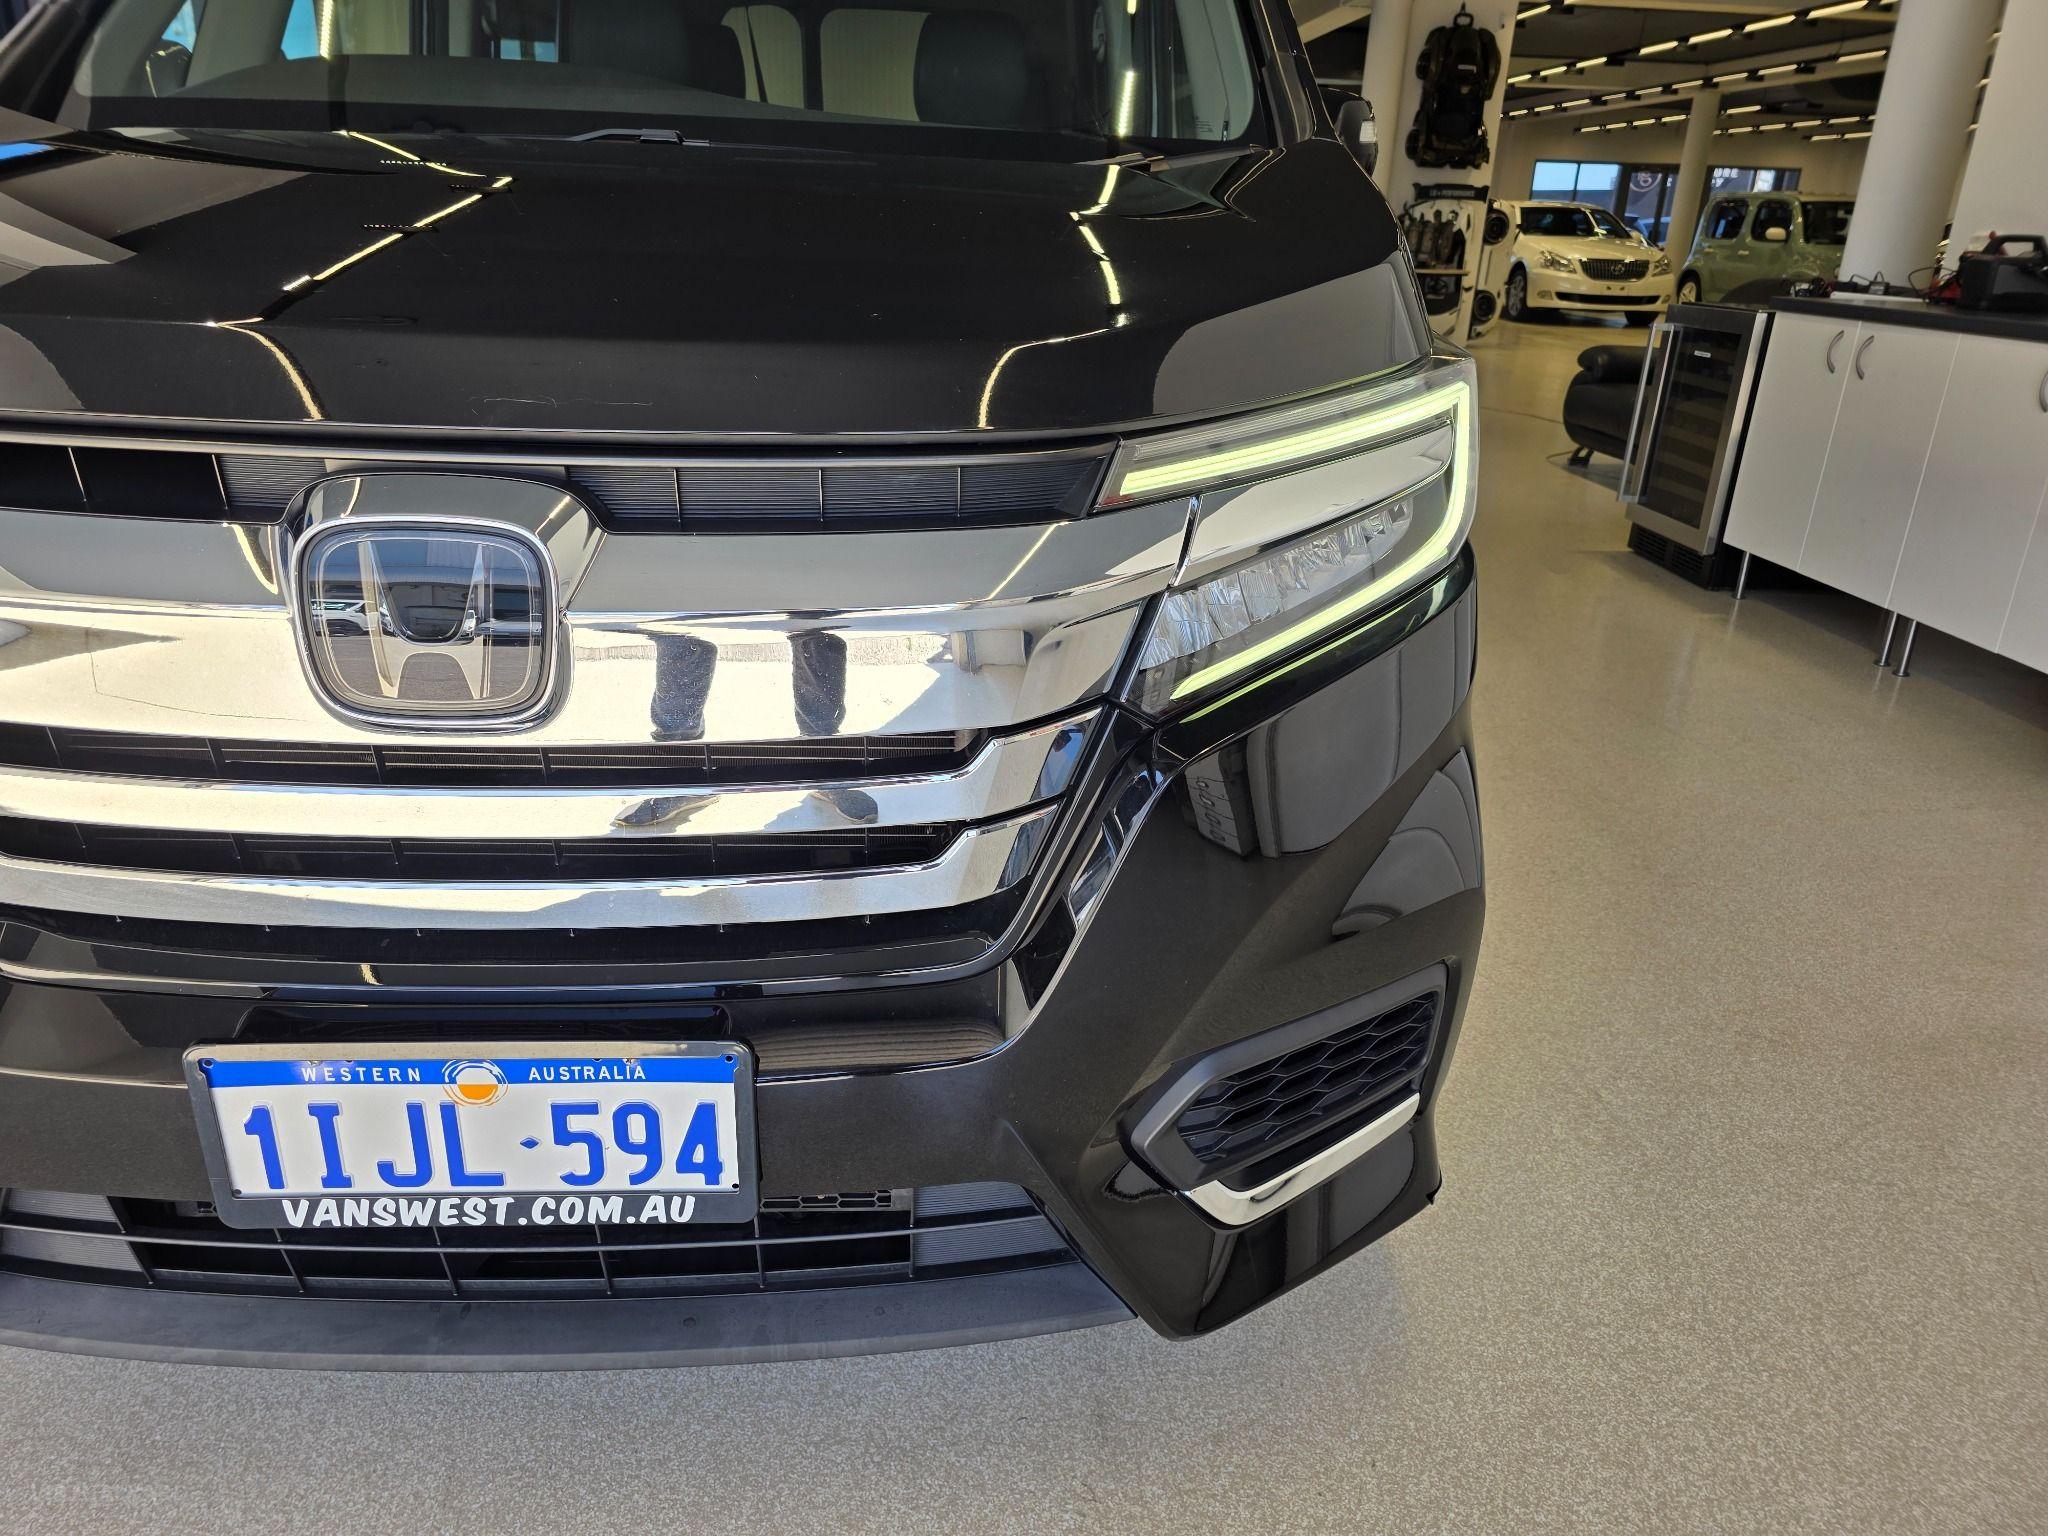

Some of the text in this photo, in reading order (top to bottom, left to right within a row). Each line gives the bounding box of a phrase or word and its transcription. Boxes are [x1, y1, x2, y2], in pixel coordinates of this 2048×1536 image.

[301, 1065, 646, 1082] WESTERN AUSTRALIA
[282, 1195, 697, 1228] VANSWEST.COM.AU
